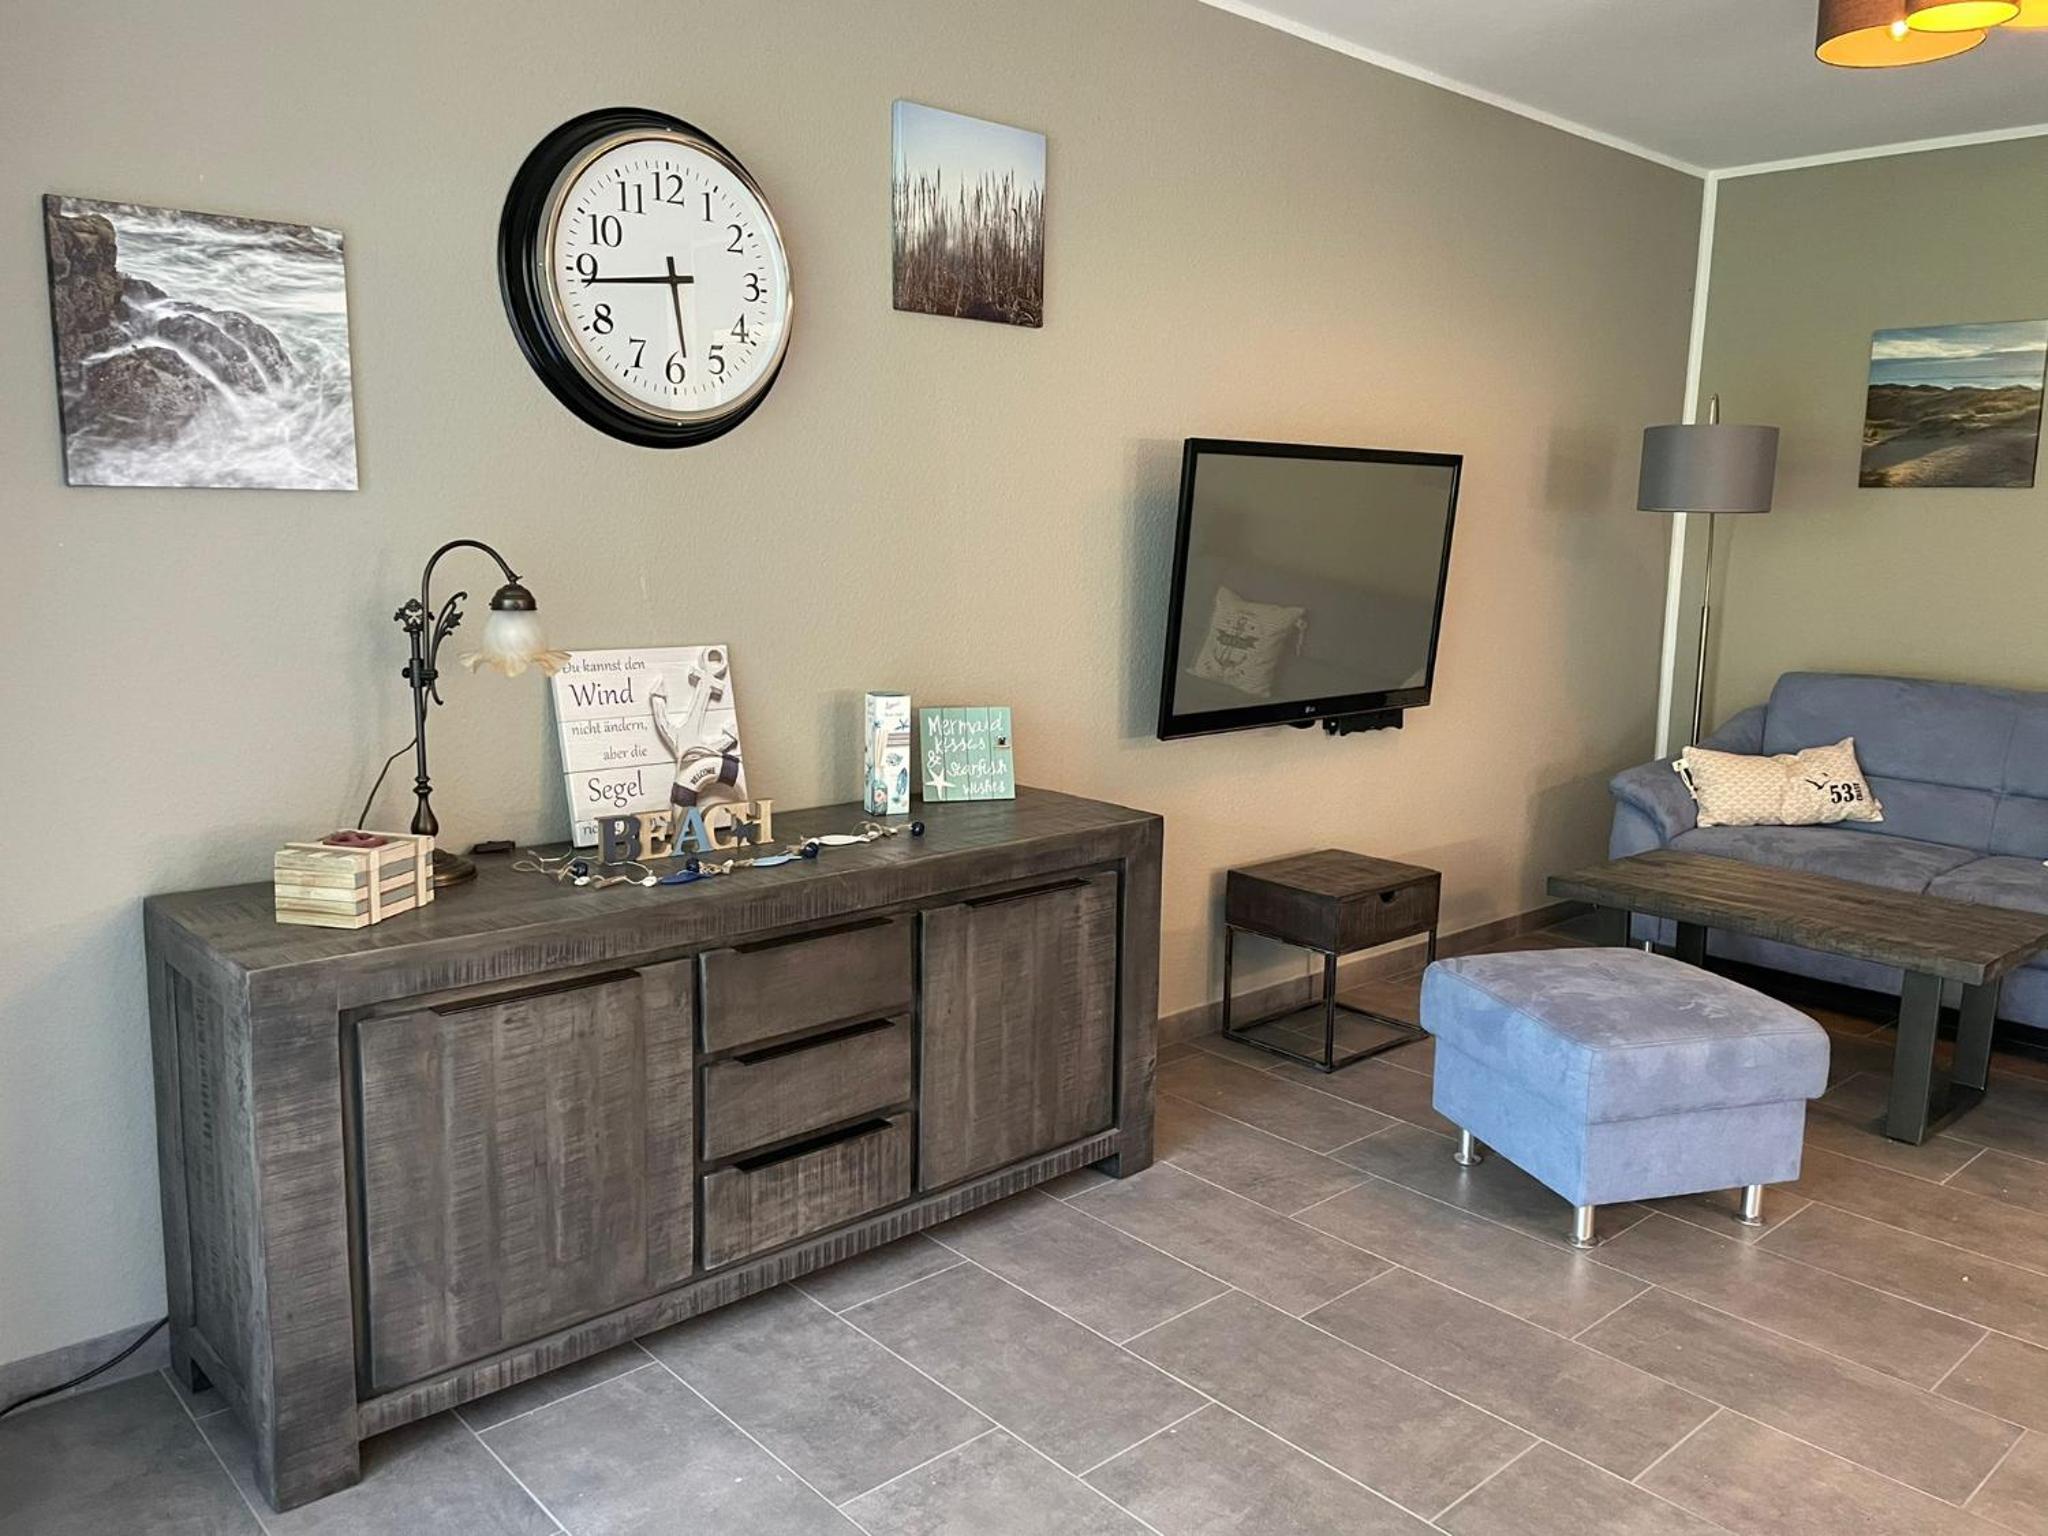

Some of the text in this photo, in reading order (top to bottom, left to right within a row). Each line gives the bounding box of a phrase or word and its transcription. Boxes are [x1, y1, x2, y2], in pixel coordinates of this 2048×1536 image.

[616, 181, 647, 215] 11
[652, 172, 685, 207] 12
[701, 192, 714, 222] 1
[588, 214, 623, 247] 10
[726, 224, 744, 254] 2
[575, 253, 599, 289] 9
[743, 272, 761, 302] 3
[592, 303, 614, 335] 8
[731, 313, 750, 344] 4
[628, 336, 647, 369] 7
[665, 351, 686, 384] 6
[708, 345, 726, 375] 5
[582, 658, 622, 673] kannst
[624, 656, 646, 671] den
[568, 677, 635, 707] Wind
[571, 719, 602, 735] nicht
[927, 711, 1004, 736] Mermaid
[602, 744, 648, 760] aber die
[587, 770, 645, 808] Segel
[1830, 783, 1854, 804] 53
[594, 799, 774, 863] BEACH
